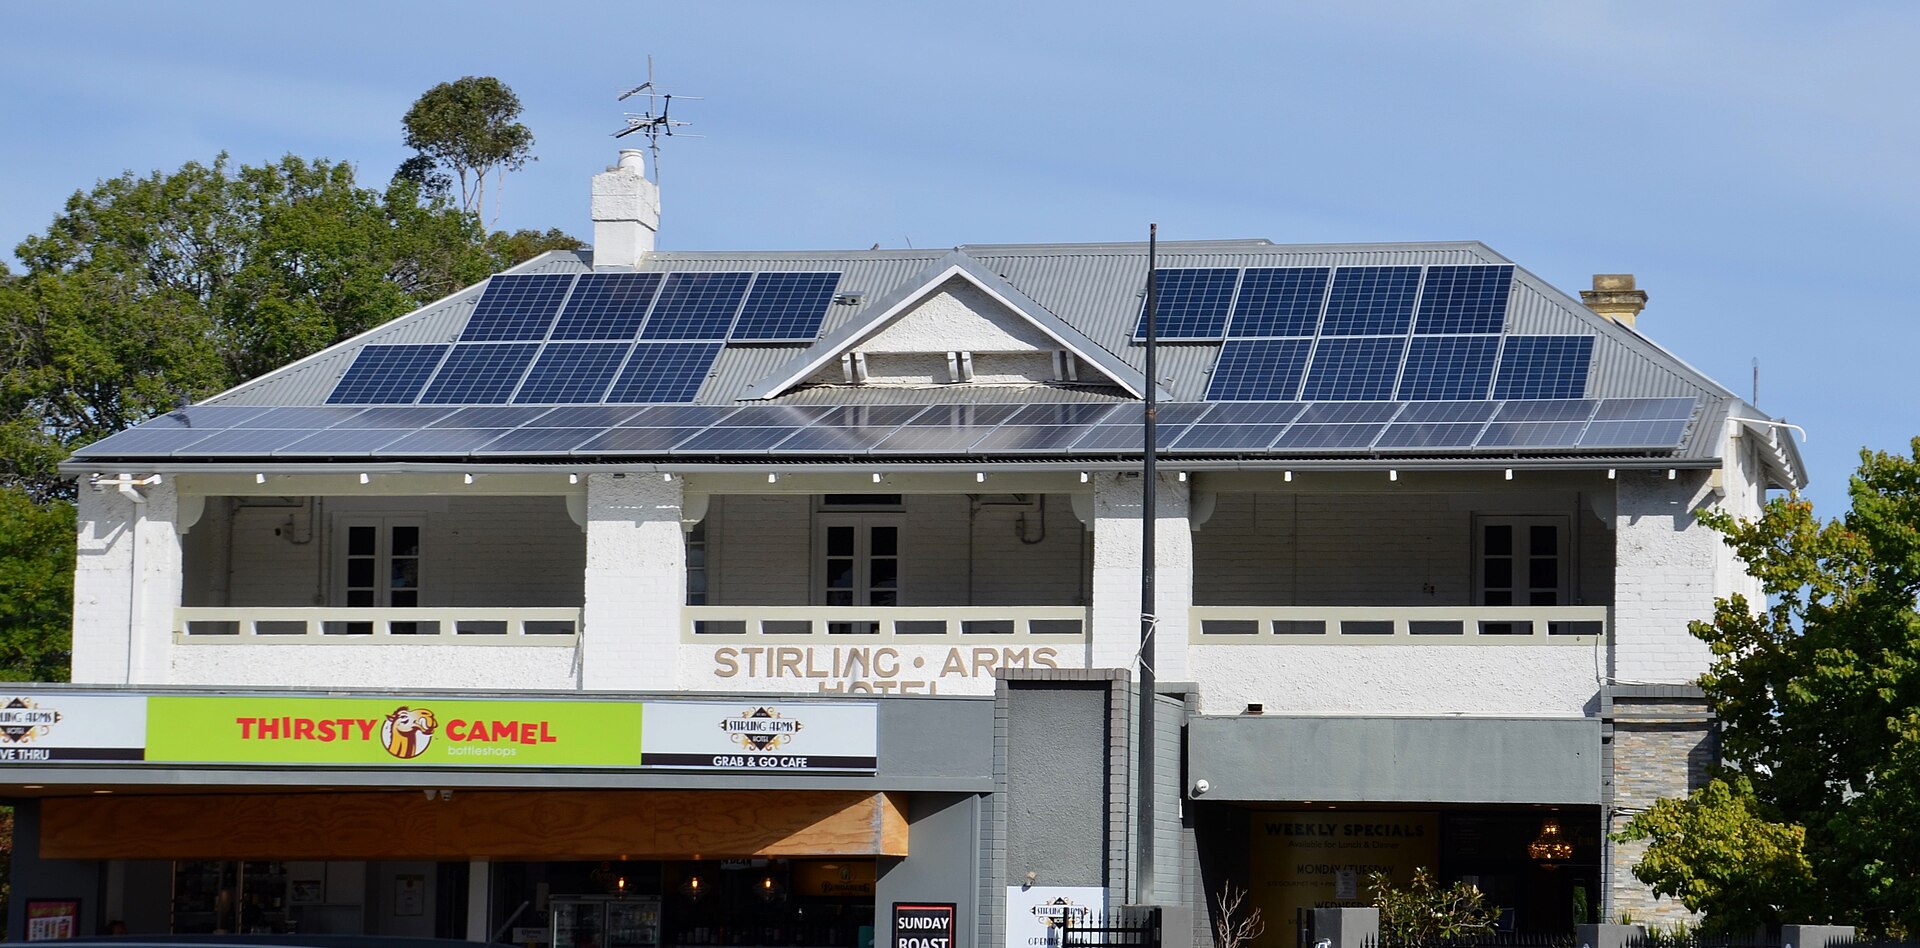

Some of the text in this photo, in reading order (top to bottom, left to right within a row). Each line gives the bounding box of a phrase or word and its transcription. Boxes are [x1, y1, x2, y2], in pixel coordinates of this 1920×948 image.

[713, 647, 1058, 678] STIRLING ARMS
[25, 712, 52, 723] ARMS
[236, 716, 557, 745] THIRSTY CAMEL
[729, 720, 793, 732] STIRLING ARMS
[752, 735, 769, 743] HOTEL
[18, 749, 50, 760] THRU
[447, 746, 517, 757] bottleshops
[713, 756, 808, 768] GRAB & GO CAFE
[1264, 823, 1425, 837] WEEKLY SPECIALS
[1287, 840, 1400, 849] Available for Lunch & Dinner
[1296, 863, 1342, 875] MONDAY
[1348, 864, 1395, 875] TUESDAY
[1037, 907, 1064, 916] STIRLING
[898, 917, 950, 930] SUNDAY
[898, 938, 949, 948] ROAST
[1028, 937, 1061, 946] OPENING
